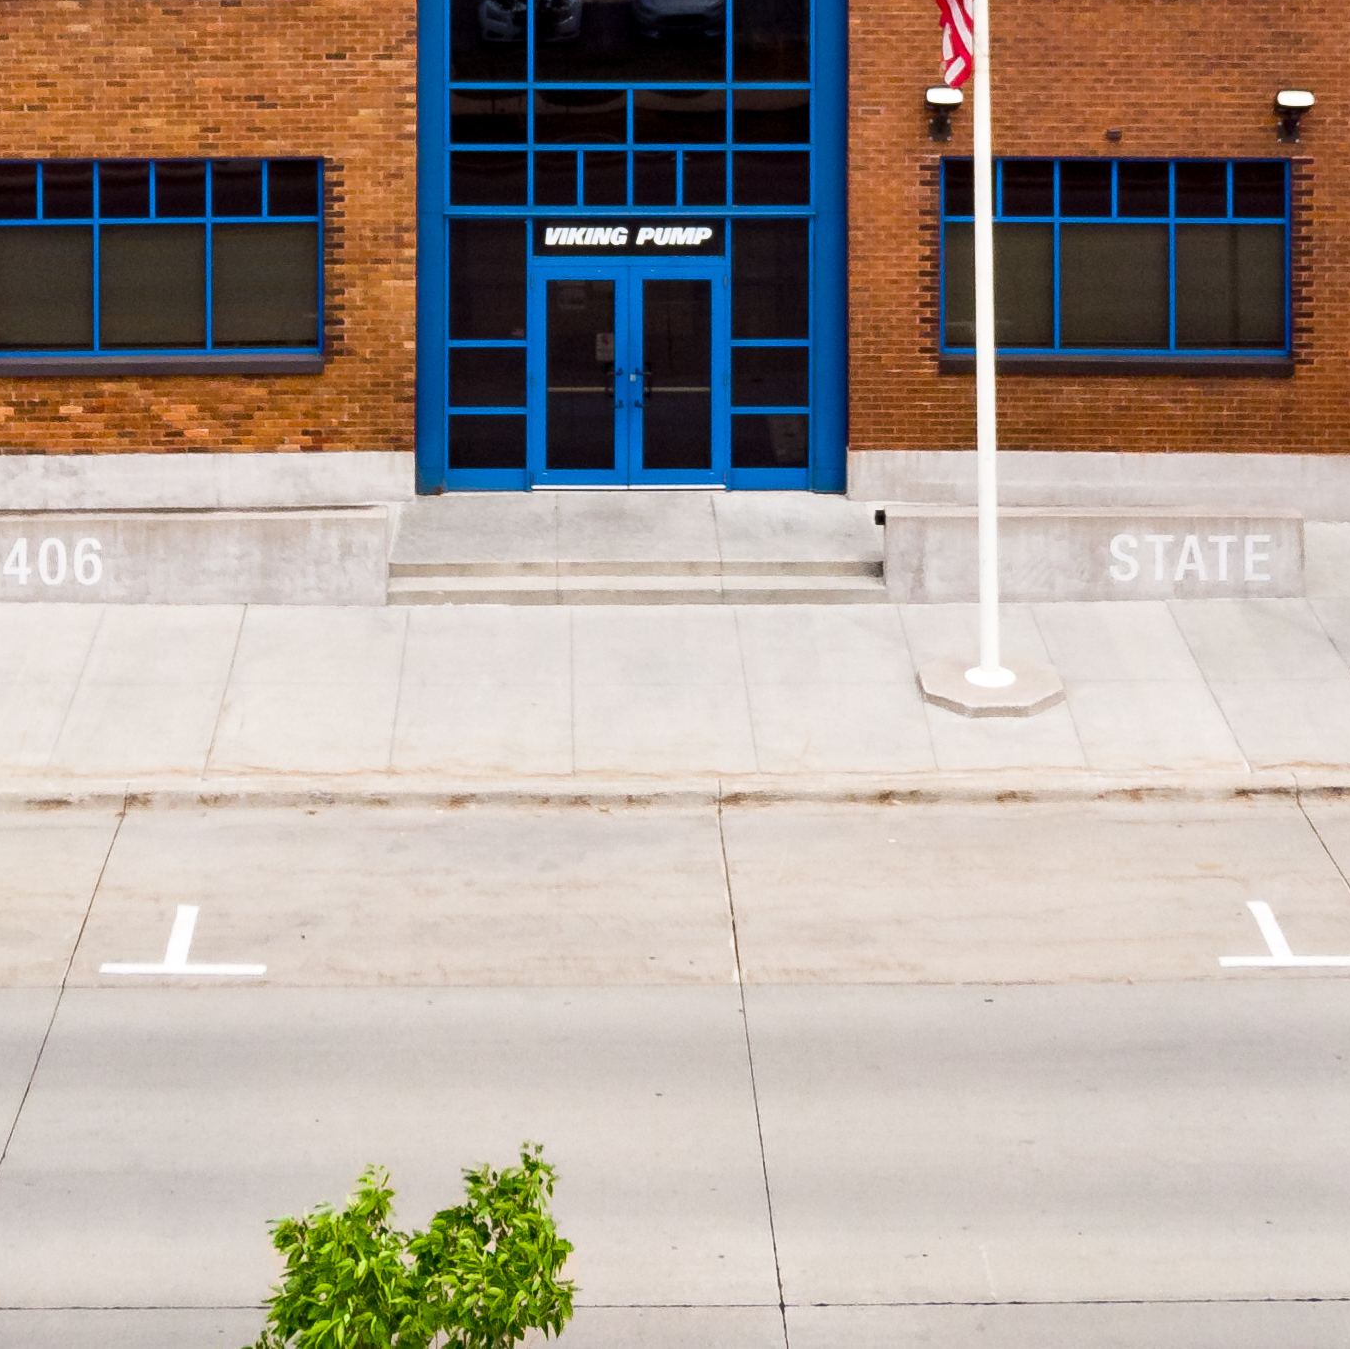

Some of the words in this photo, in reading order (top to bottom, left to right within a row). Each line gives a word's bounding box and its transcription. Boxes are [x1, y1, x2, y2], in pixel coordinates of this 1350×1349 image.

[544, 226, 629, 246] VIKING
[635, 226, 713, 246] PUMP
[2, 537, 103, 586] 406
[1108, 533, 1272, 582] STATE
